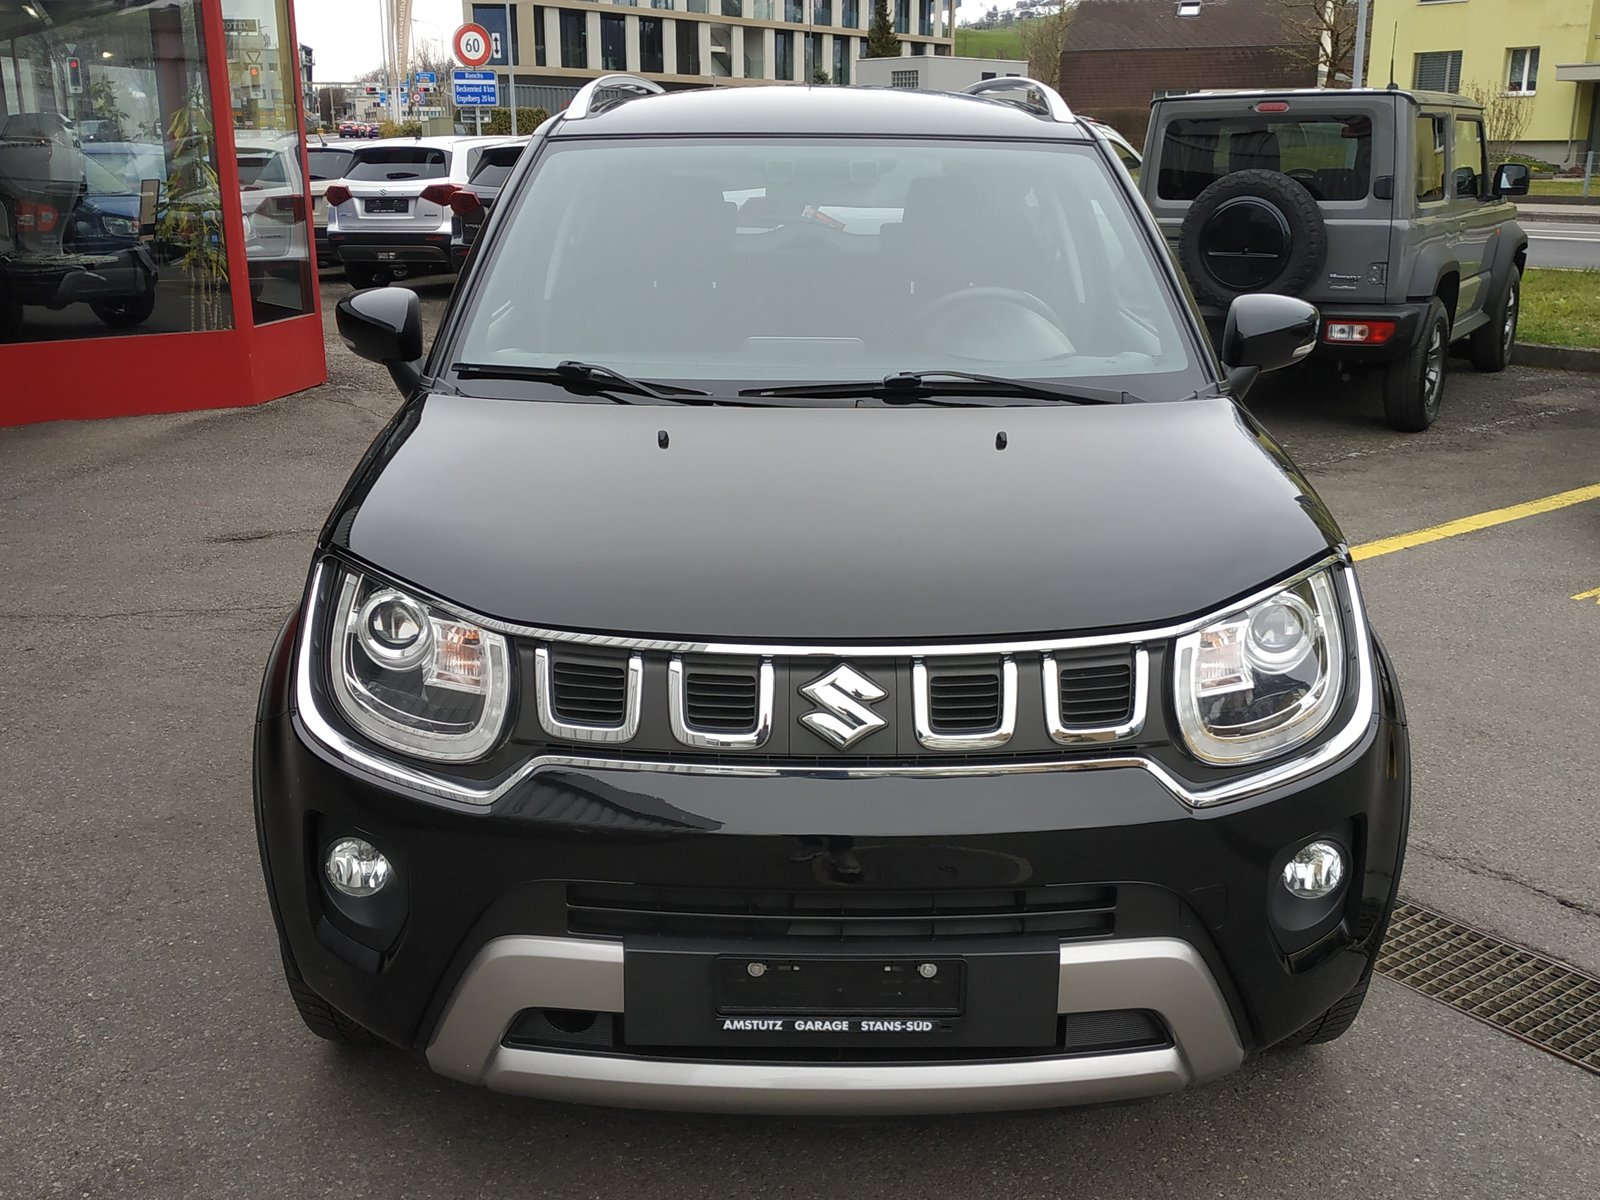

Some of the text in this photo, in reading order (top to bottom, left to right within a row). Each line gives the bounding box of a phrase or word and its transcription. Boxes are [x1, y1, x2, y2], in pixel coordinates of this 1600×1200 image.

[465, 38, 480, 53] 60
[456, 85, 482, 93] Beckenried
[456, 95, 480, 103] Engelberg
[723, 1020, 933, 1031] AMSTUTZ GARAGE STANS-SÜD
